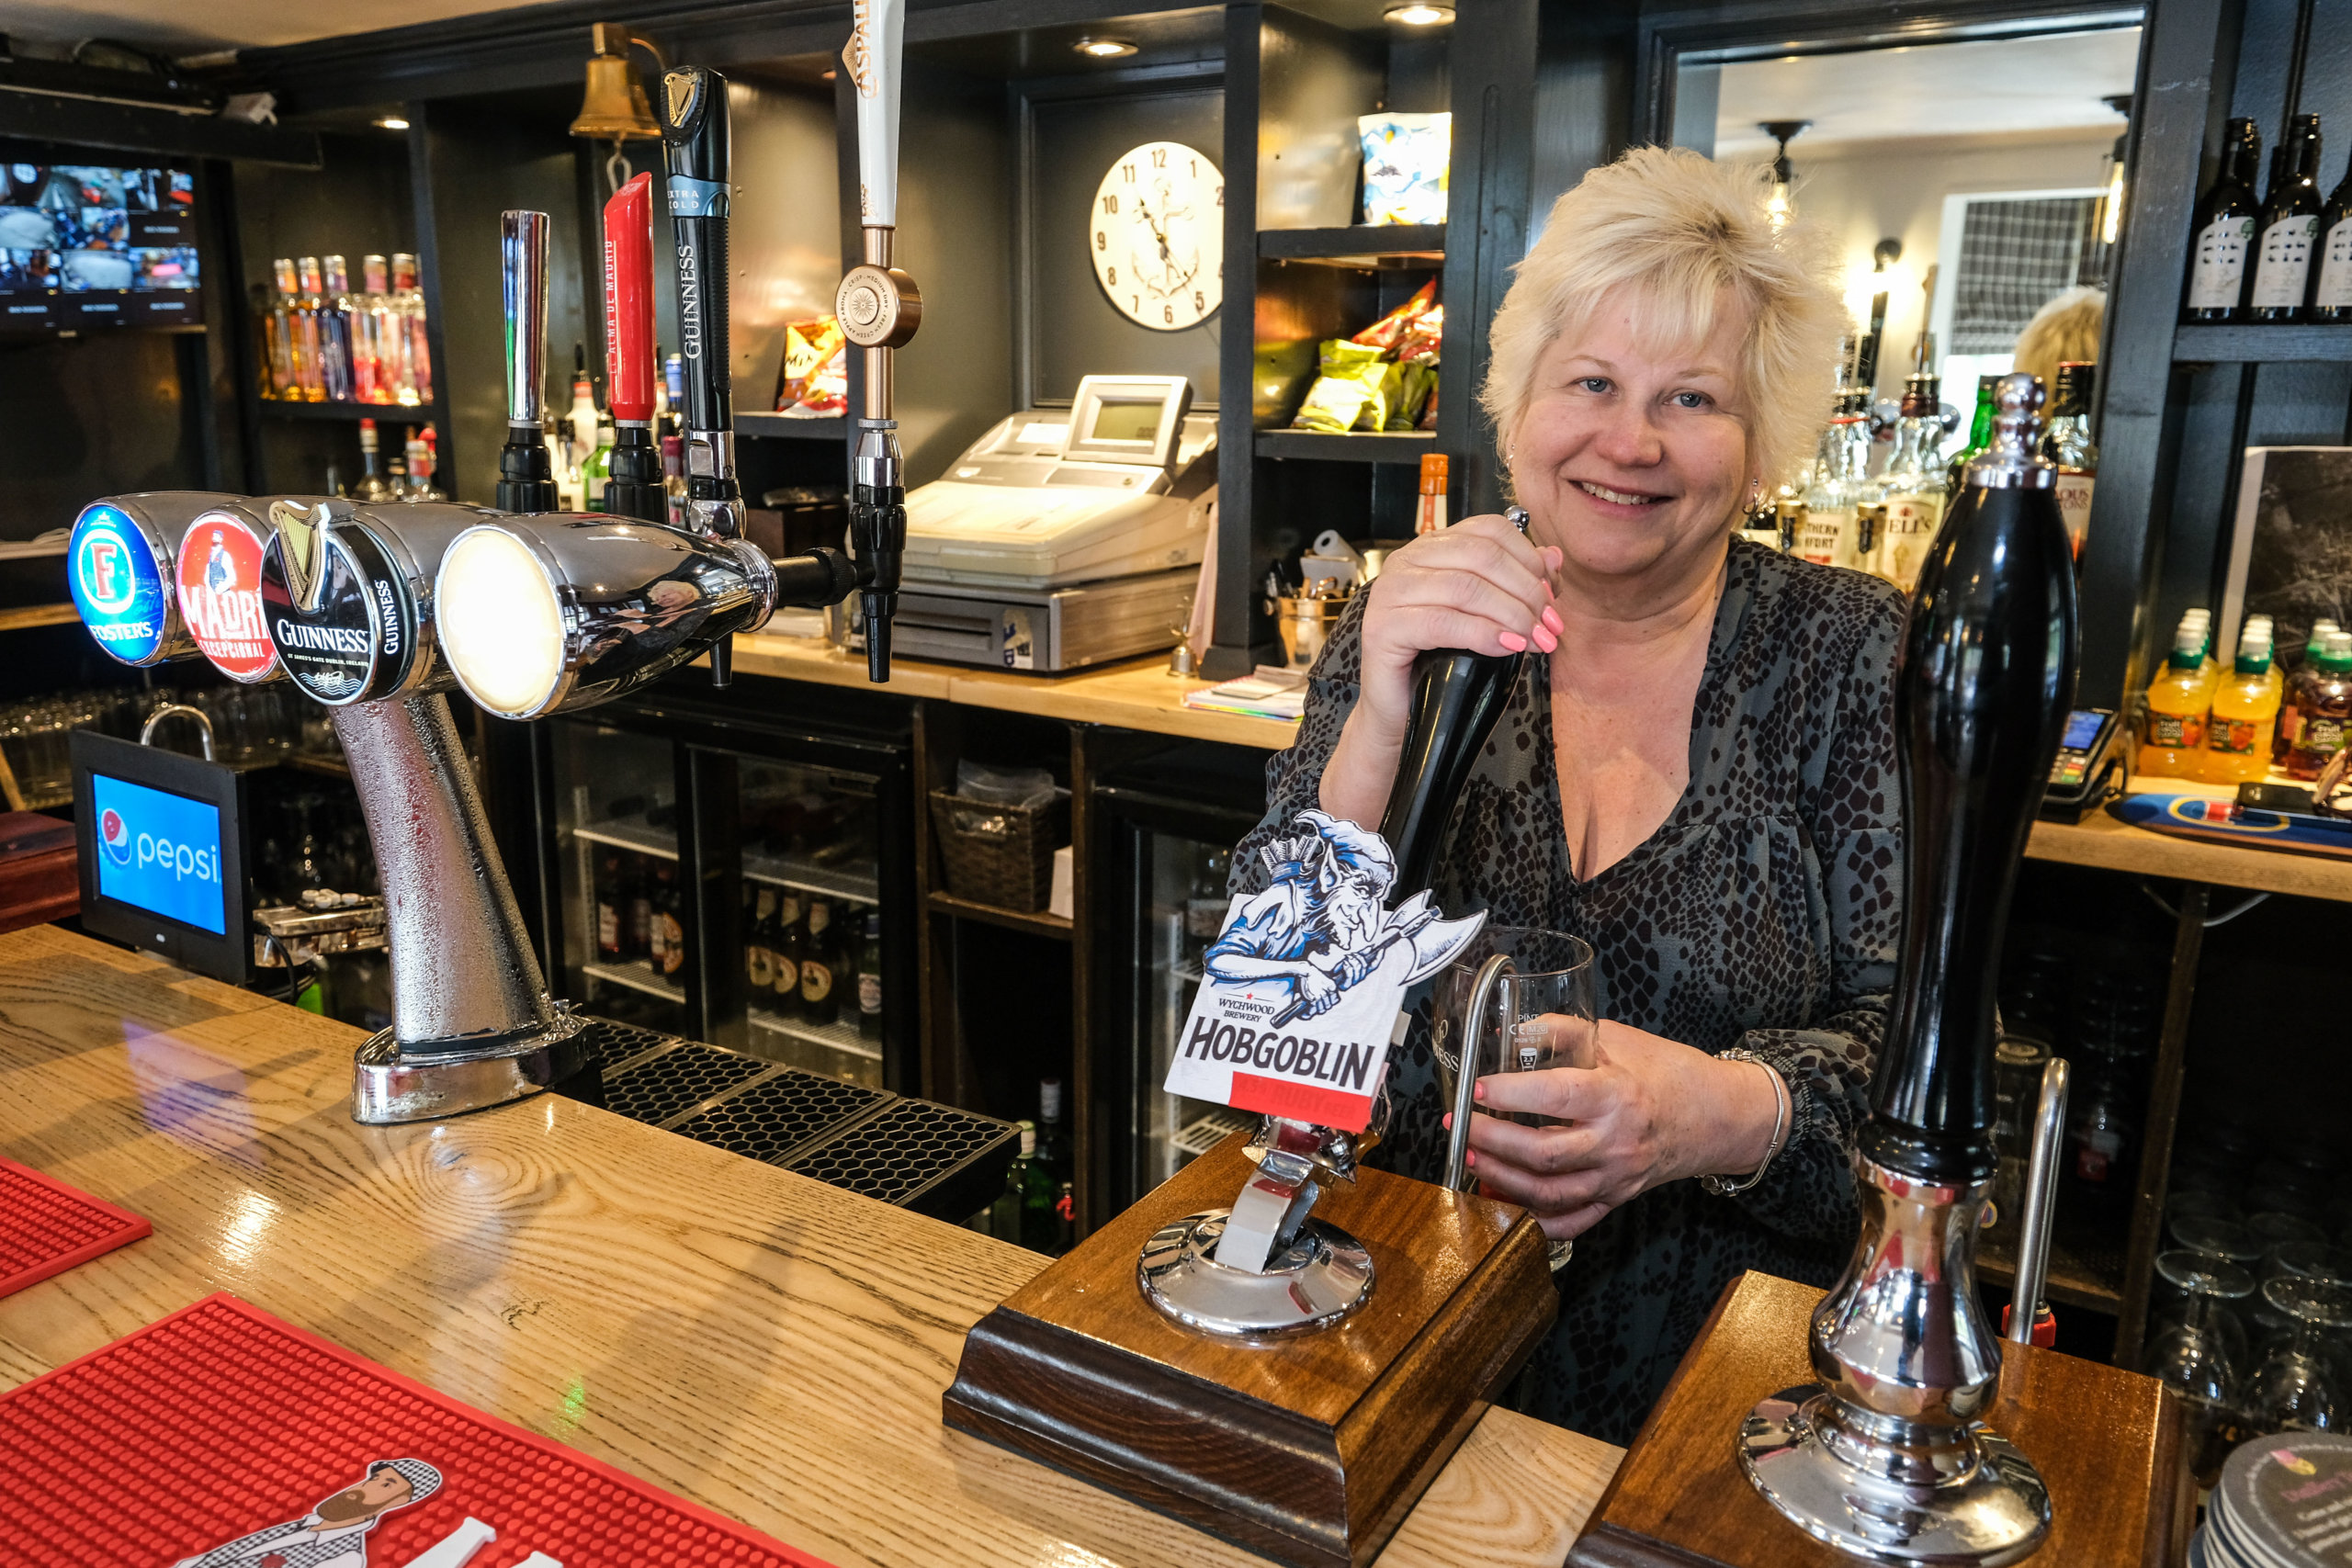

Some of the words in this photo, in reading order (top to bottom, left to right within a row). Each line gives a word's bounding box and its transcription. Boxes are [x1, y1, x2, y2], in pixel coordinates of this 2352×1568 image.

[1151, 149, 1167, 168] 12
[1123, 164, 1136, 183] 11
[1190, 159, 1196, 178] 1
[1102, 195, 1118, 214] 10
[1097, 231, 1106, 251] 9
[1107, 266, 1116, 286] 8
[678, 244, 702, 359] GUINNESS
[1132, 295, 1139, 313] 7
[1195, 291, 1204, 311] 5
[1164, 305, 1173, 323] 6
[1806, 523, 1840, 536] THERN
[1889, 516, 1931, 534] ELL'S
[1805, 537, 1835, 548] FORT
[92, 543, 117, 599] F
[375, 580, 400, 655] GUINNESS
[88, 622, 153, 641] FOSTER'S
[277, 618, 371, 653] GUINNESS
[138, 833, 218, 883] pepsi
[1219, 998, 1275, 1015] WYCHWOOD
[1224, 1010, 1261, 1022] BREWERY
[1185, 1016, 1375, 1090] HOBGOBLIN
